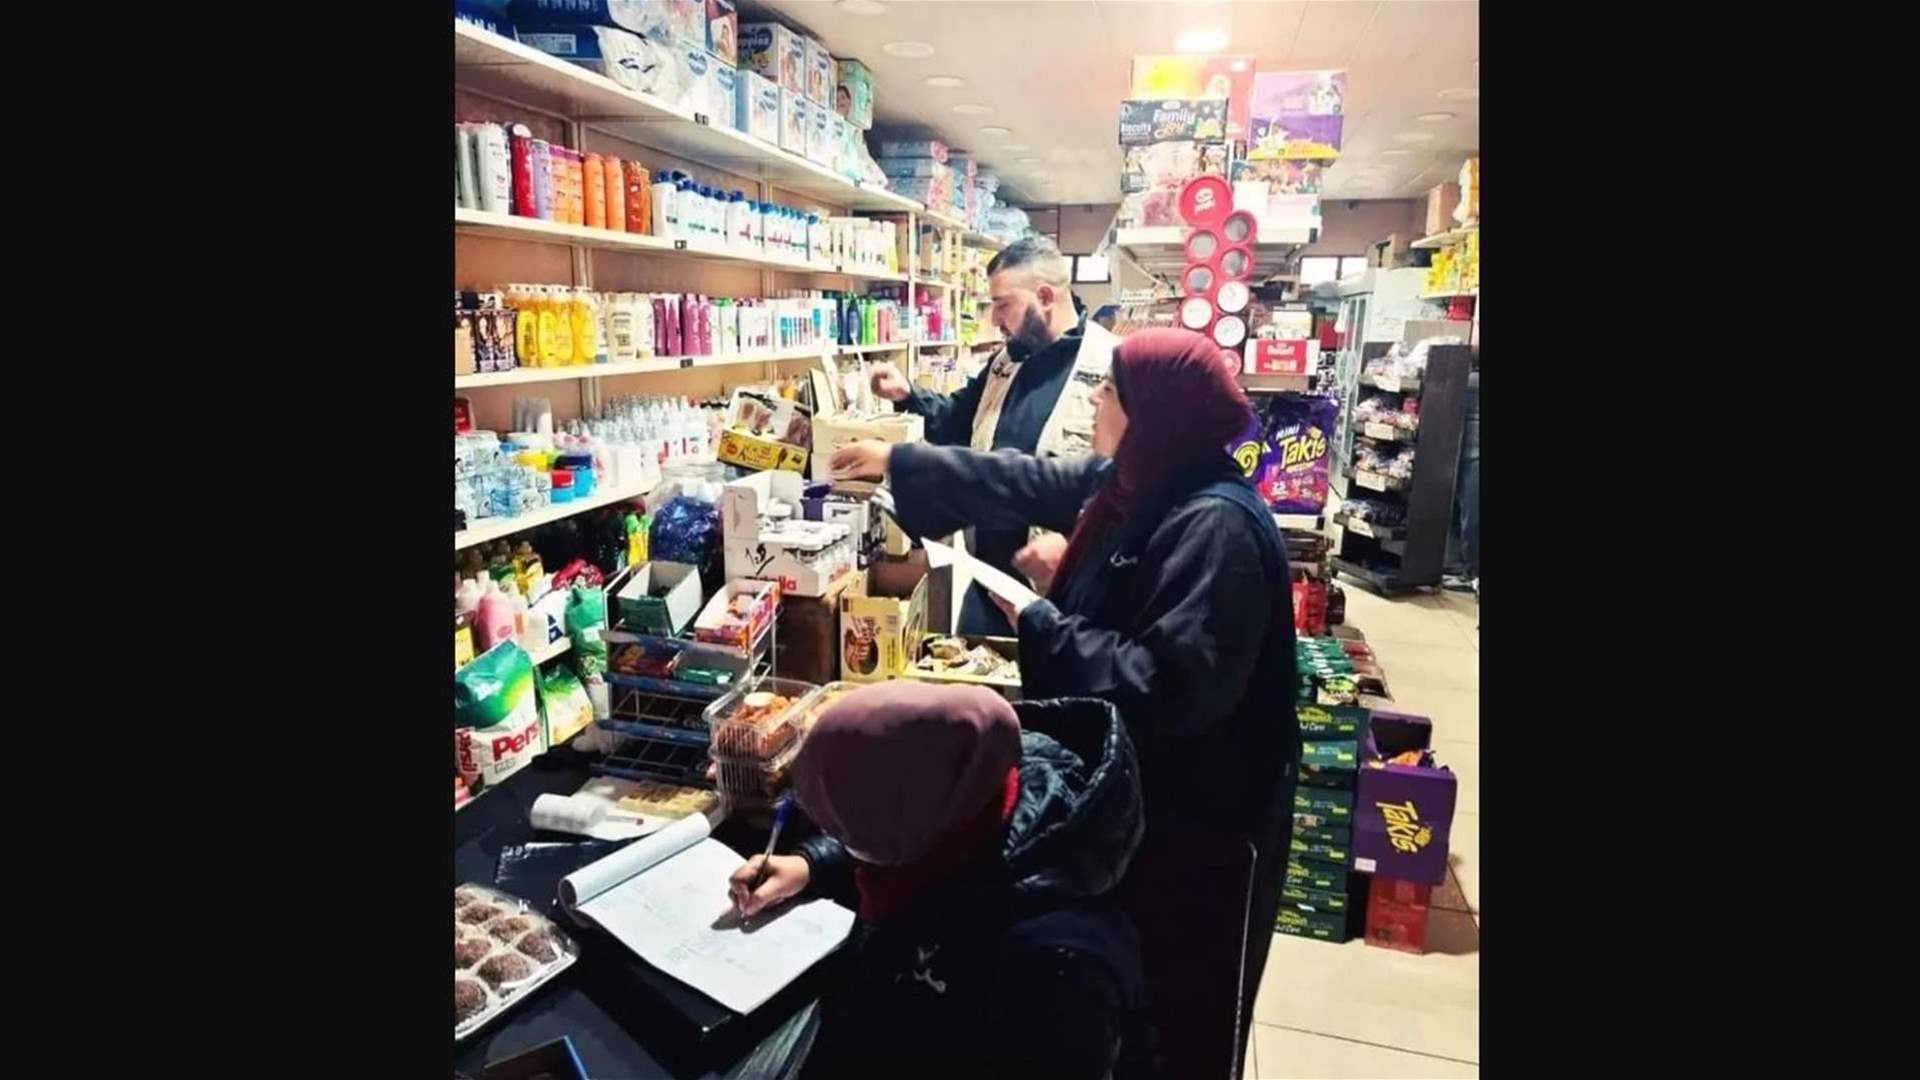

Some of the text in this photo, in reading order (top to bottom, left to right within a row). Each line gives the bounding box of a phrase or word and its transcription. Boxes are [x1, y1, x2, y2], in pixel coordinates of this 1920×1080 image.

[1154, 108, 1197, 125] Family
[1279, 435, 1327, 470] Takis
[1376, 800, 1420, 854] Takis
